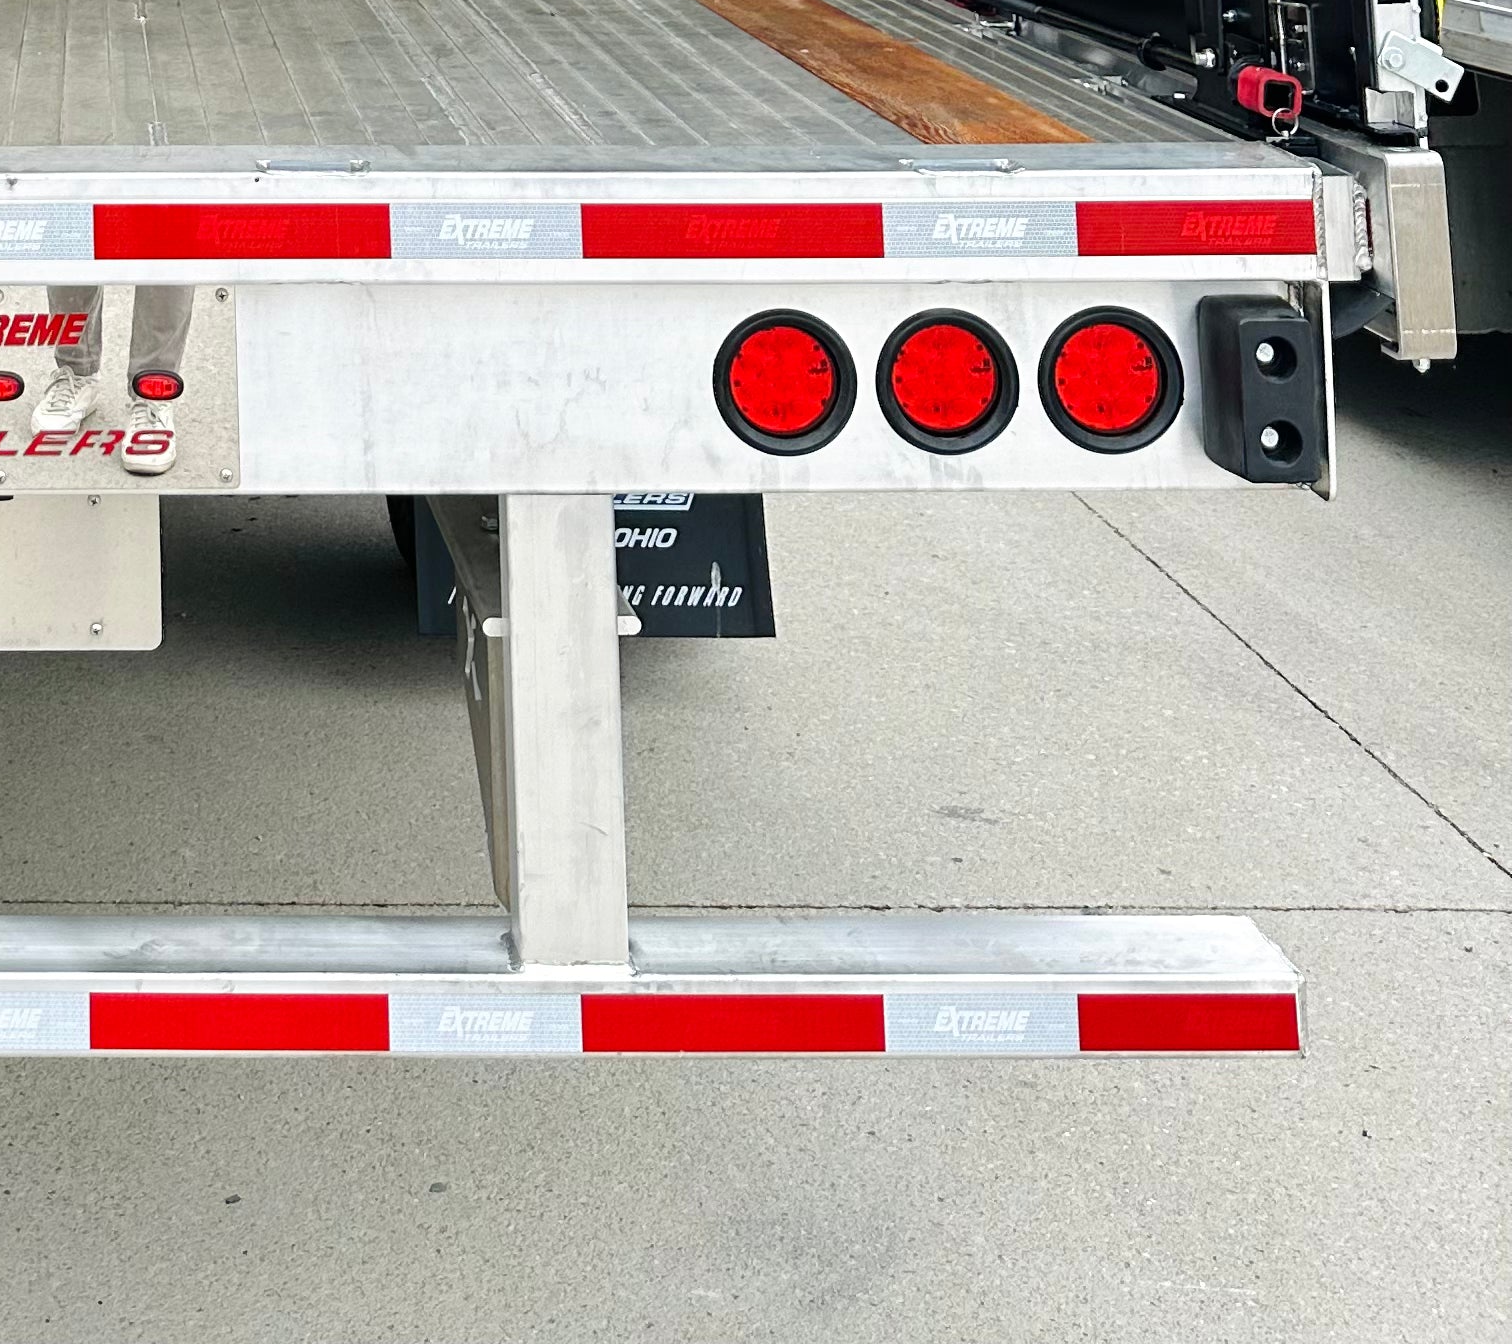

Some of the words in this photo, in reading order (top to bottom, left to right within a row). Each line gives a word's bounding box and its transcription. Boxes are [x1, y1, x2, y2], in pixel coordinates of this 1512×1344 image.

[439, 214, 535, 245] EXTREME
[932, 213, 1029, 244] EXTREME
[614, 527, 678, 548] OHIO
[651, 585, 743, 607] FORWARD
[438, 1006, 535, 1037] EXTREME
[934, 1006, 1030, 1036] EXTREME
